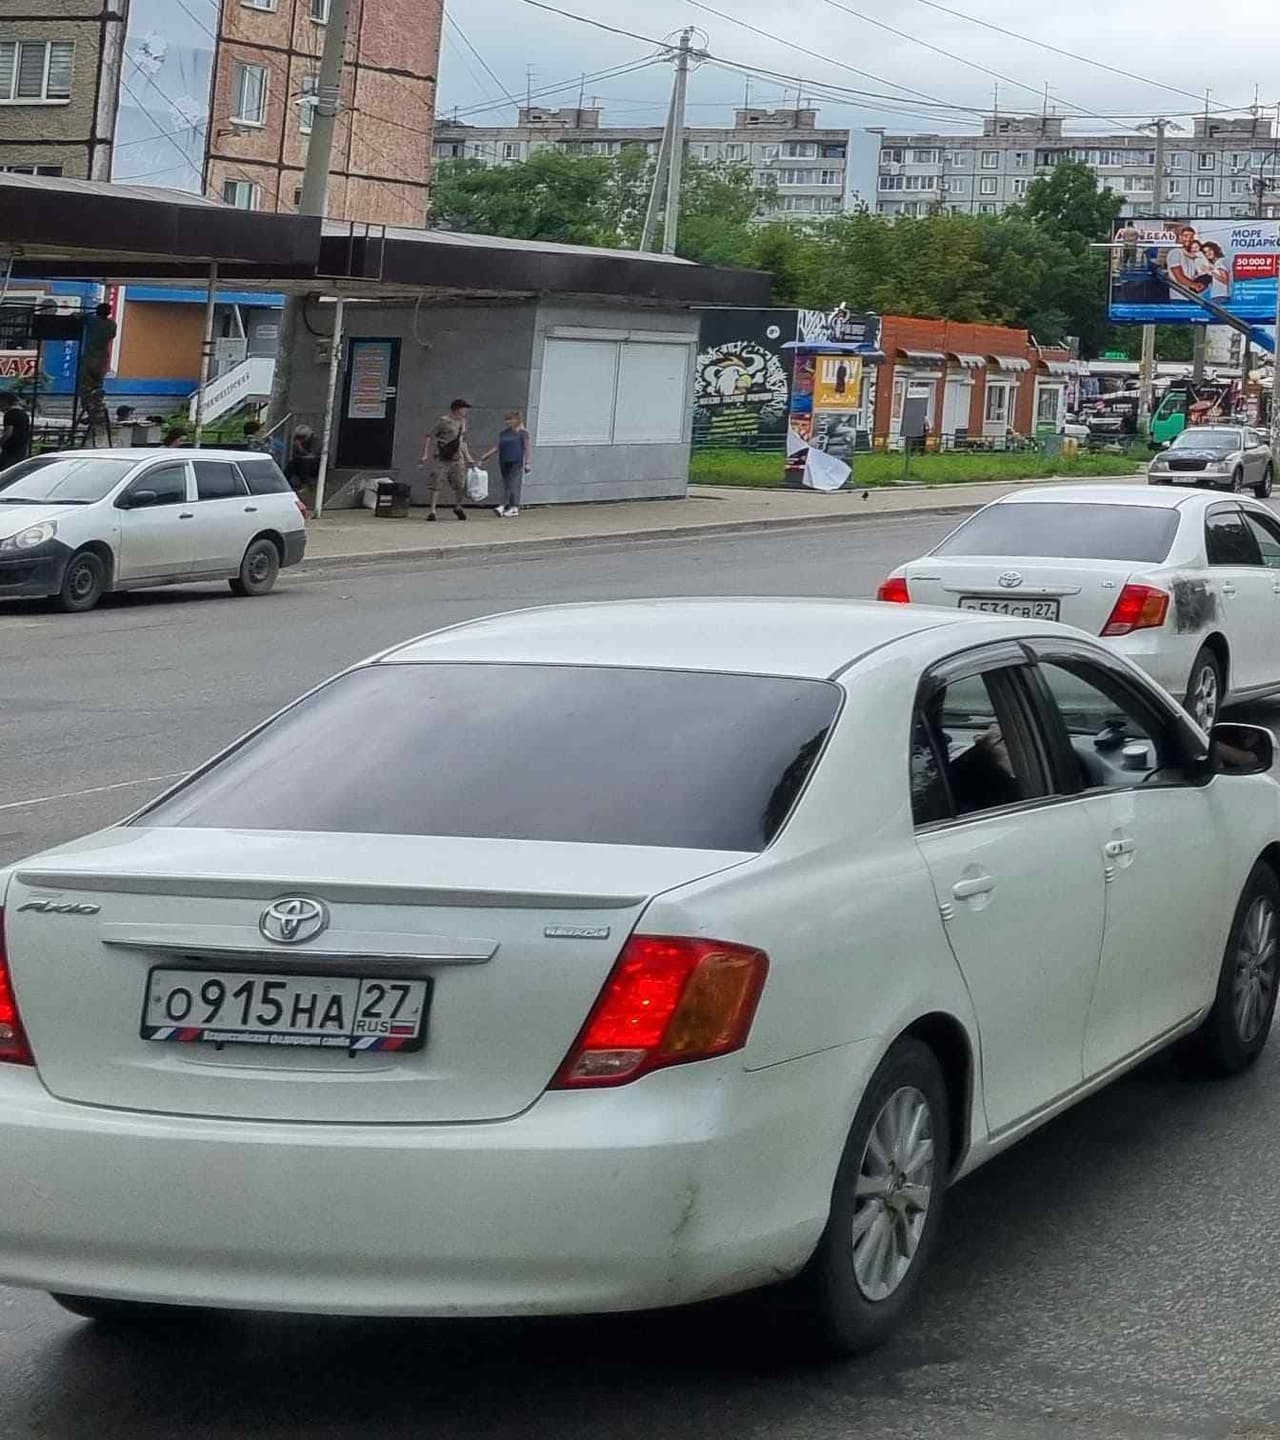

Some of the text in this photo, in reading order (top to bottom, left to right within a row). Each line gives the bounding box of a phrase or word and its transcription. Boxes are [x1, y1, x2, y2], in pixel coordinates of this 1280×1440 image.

[1036, 603, 1051, 616] 27
[361, 984, 411, 1019] 27
[356, 1020, 388, 1033] RUS
